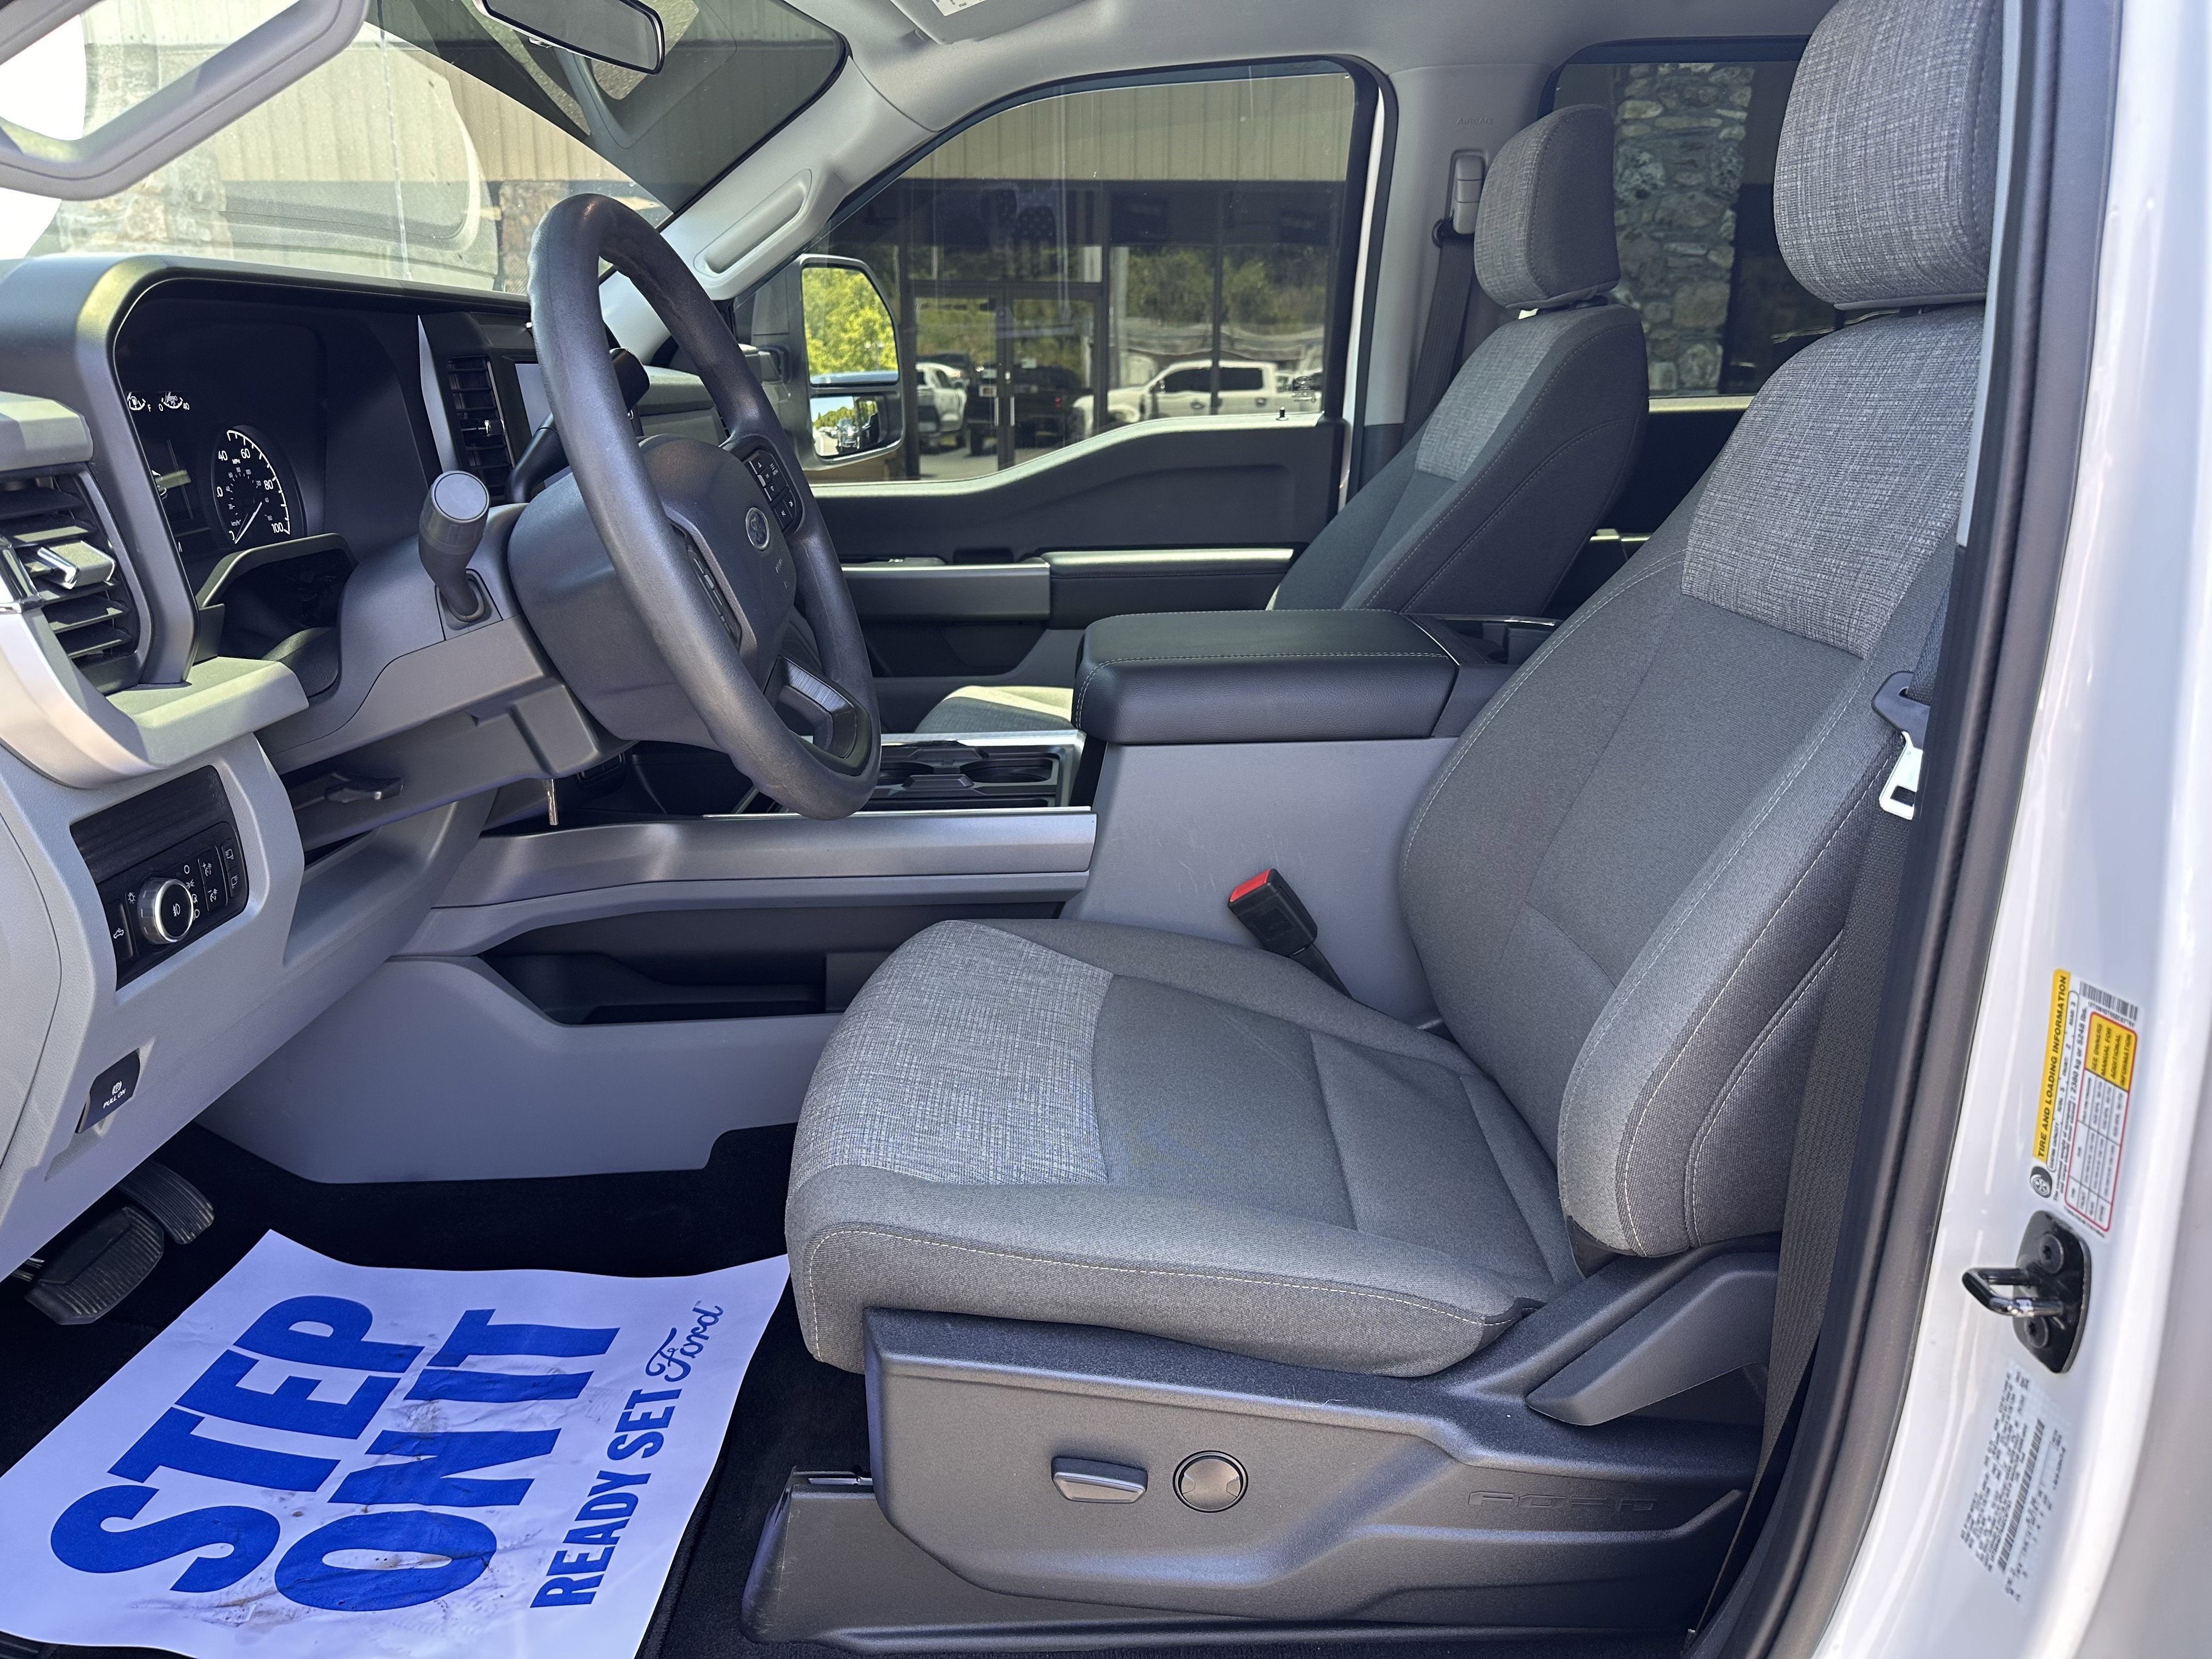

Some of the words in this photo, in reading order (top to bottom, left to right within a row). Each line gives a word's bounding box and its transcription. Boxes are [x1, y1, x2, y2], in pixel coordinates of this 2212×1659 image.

[218, 450, 228, 461] 40
[241, 448, 251, 459] 60
[263, 479, 274, 490] 80
[271, 522, 284, 533] 100
[2094, 1023, 2102, 1055] OWNERS
[2074, 1058, 2081, 1070] kg
[2076, 1048, 2081, 1057] or
[2100, 1045, 2109, 1076] MANUAL
[2110, 1034, 2121, 1080] ADDITIONAL
[2119, 1034, 2131, 1087] INFORMATION
[2039, 1132, 2047, 1157] TIRE
[2045, 1056, 2057, 1105] LOADING
[2052, 975, 2067, 1053] INFORMATION
[2070, 1071, 2078, 1093] 2380
[103, 1096, 117, 1108] PULL
[118, 1088, 126, 1098] ON
[404, 1308, 620, 1403] IT
[51, 1295, 425, 1593] STEP
[530, 1471, 651, 1608] READY
[607, 1389, 681, 1460] SET
[646, 1306, 724, 1382] Ford
[1468, 1489, 1658, 1511] FORD
[275, 1427, 562, 1611] ON
